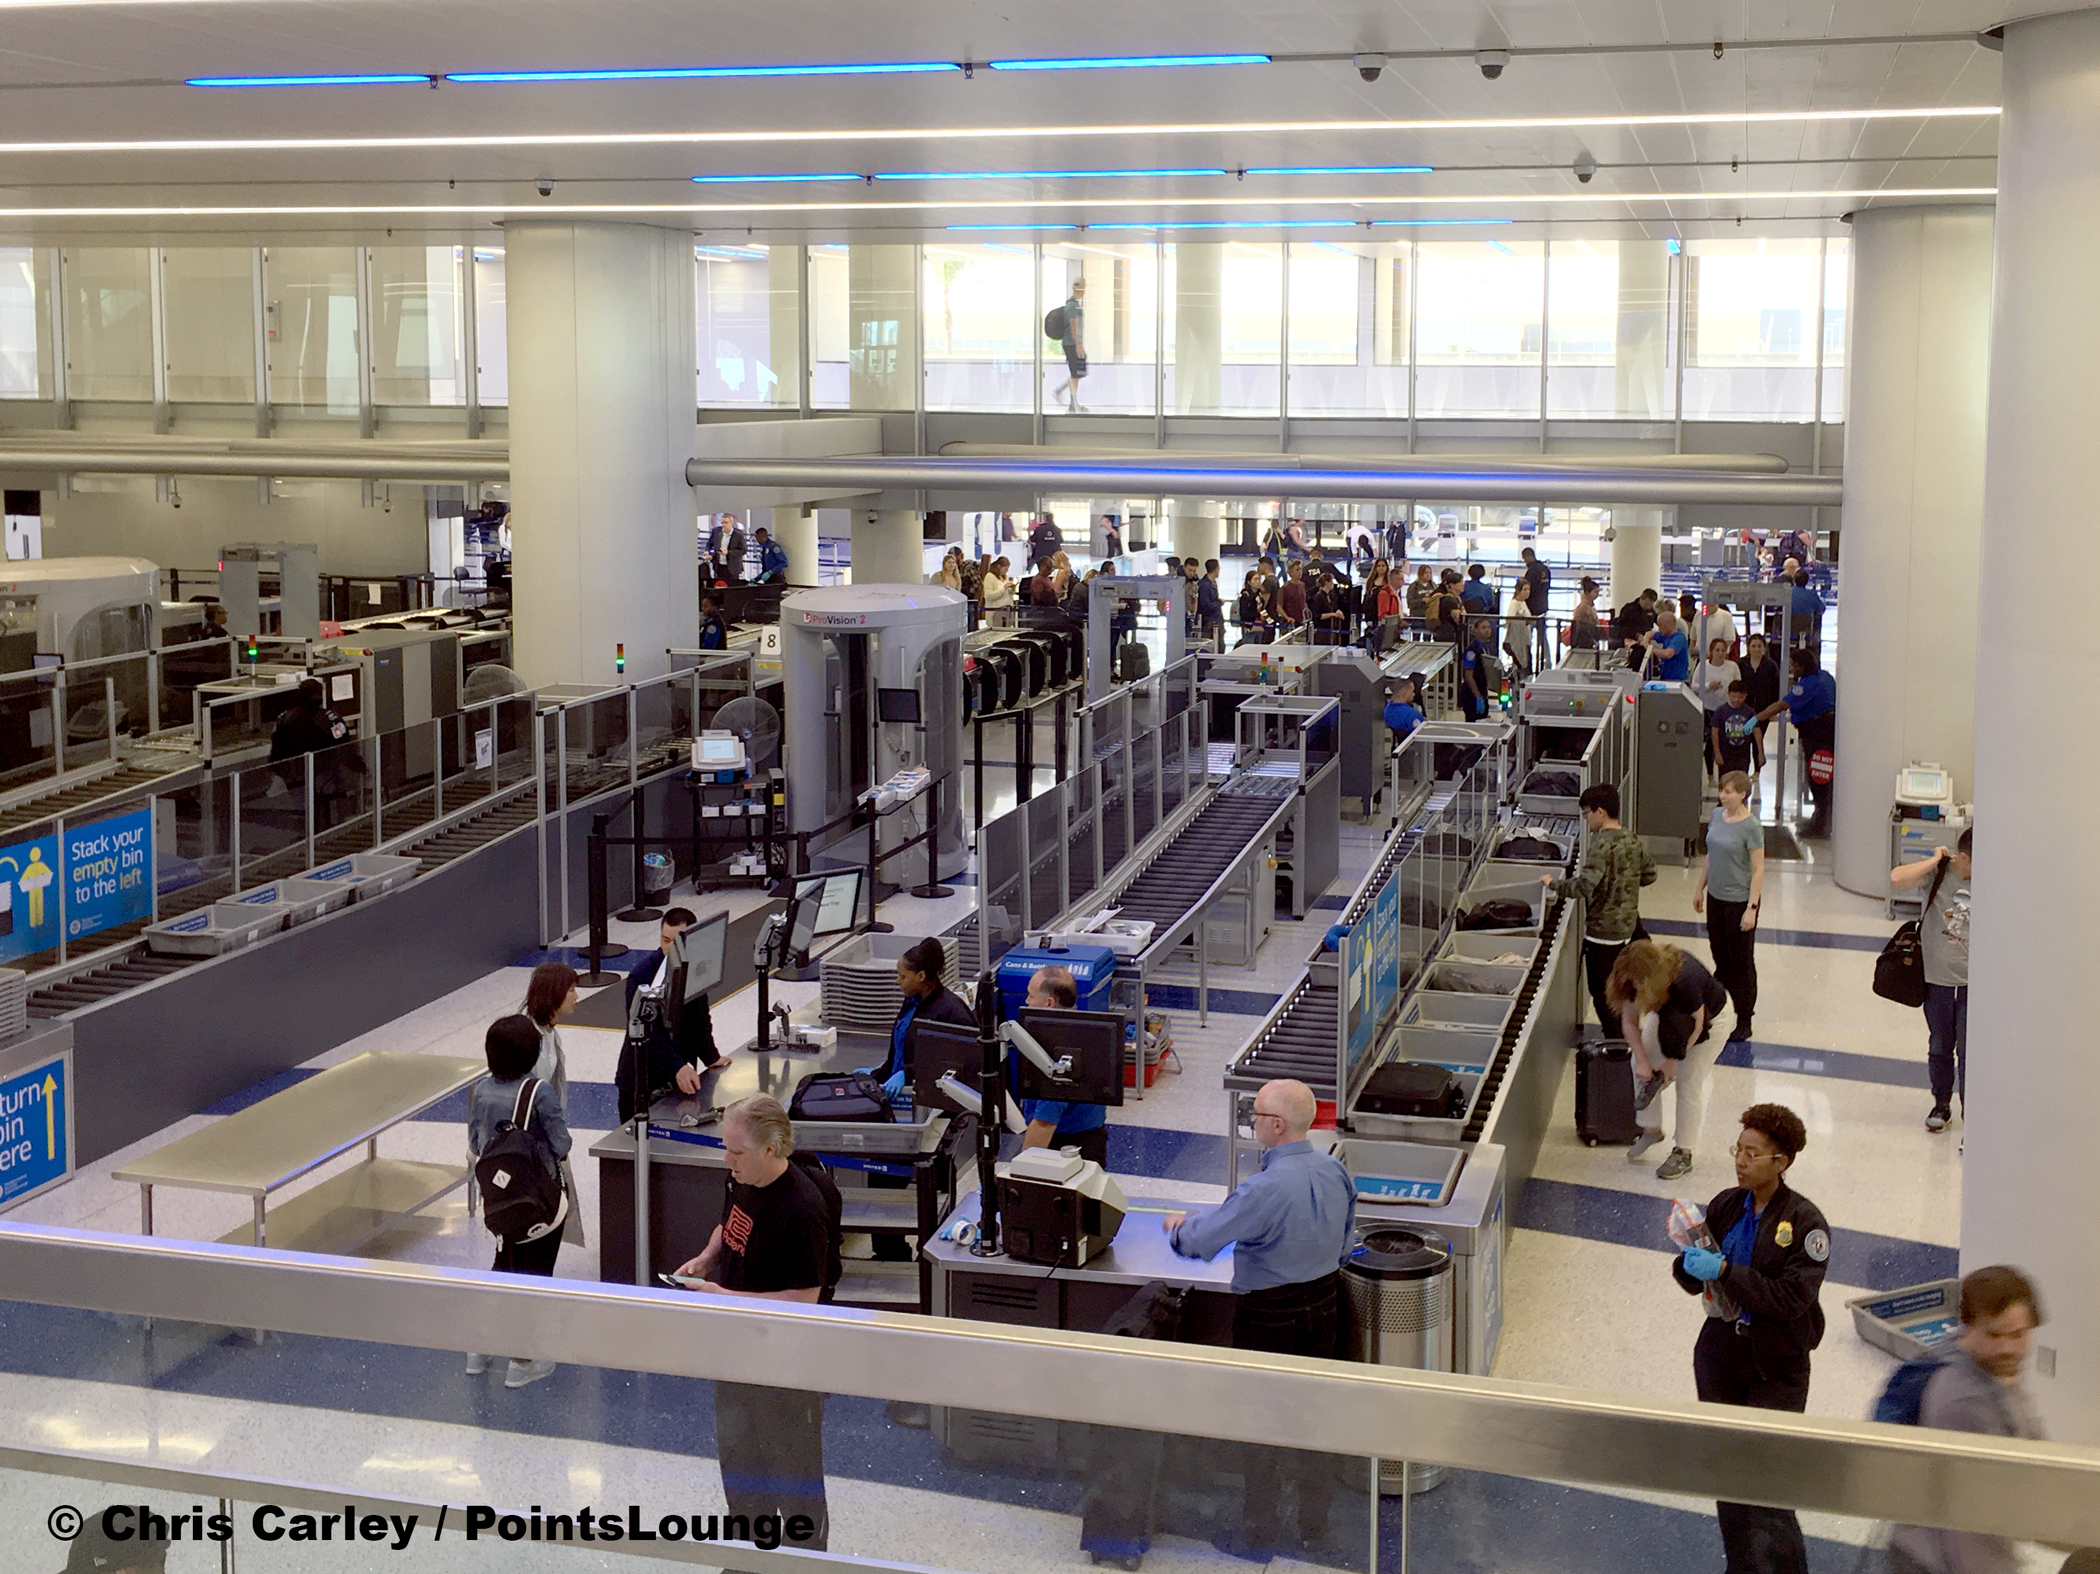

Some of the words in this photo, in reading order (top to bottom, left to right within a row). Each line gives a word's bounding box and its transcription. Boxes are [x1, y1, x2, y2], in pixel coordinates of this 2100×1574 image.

[1308, 568, 1321, 576] TSA
[860, 614, 867, 625] 2
[767, 634, 776, 648] 8
[1812, 753, 1821, 761] DO
[1821, 756, 1833, 764] NOT
[1811, 770, 1830, 778] ENTER
[72, 834, 109, 861] Stack
[112, 827, 144, 852] your
[73, 856, 118, 882] empty
[122, 847, 143, 868] bin
[75, 886, 91, 904] to
[93, 878, 117, 898] the
[120, 867, 142, 890] left
[0, 1082, 41, 1117] turn
[0, 1140, 32, 1171] ere
